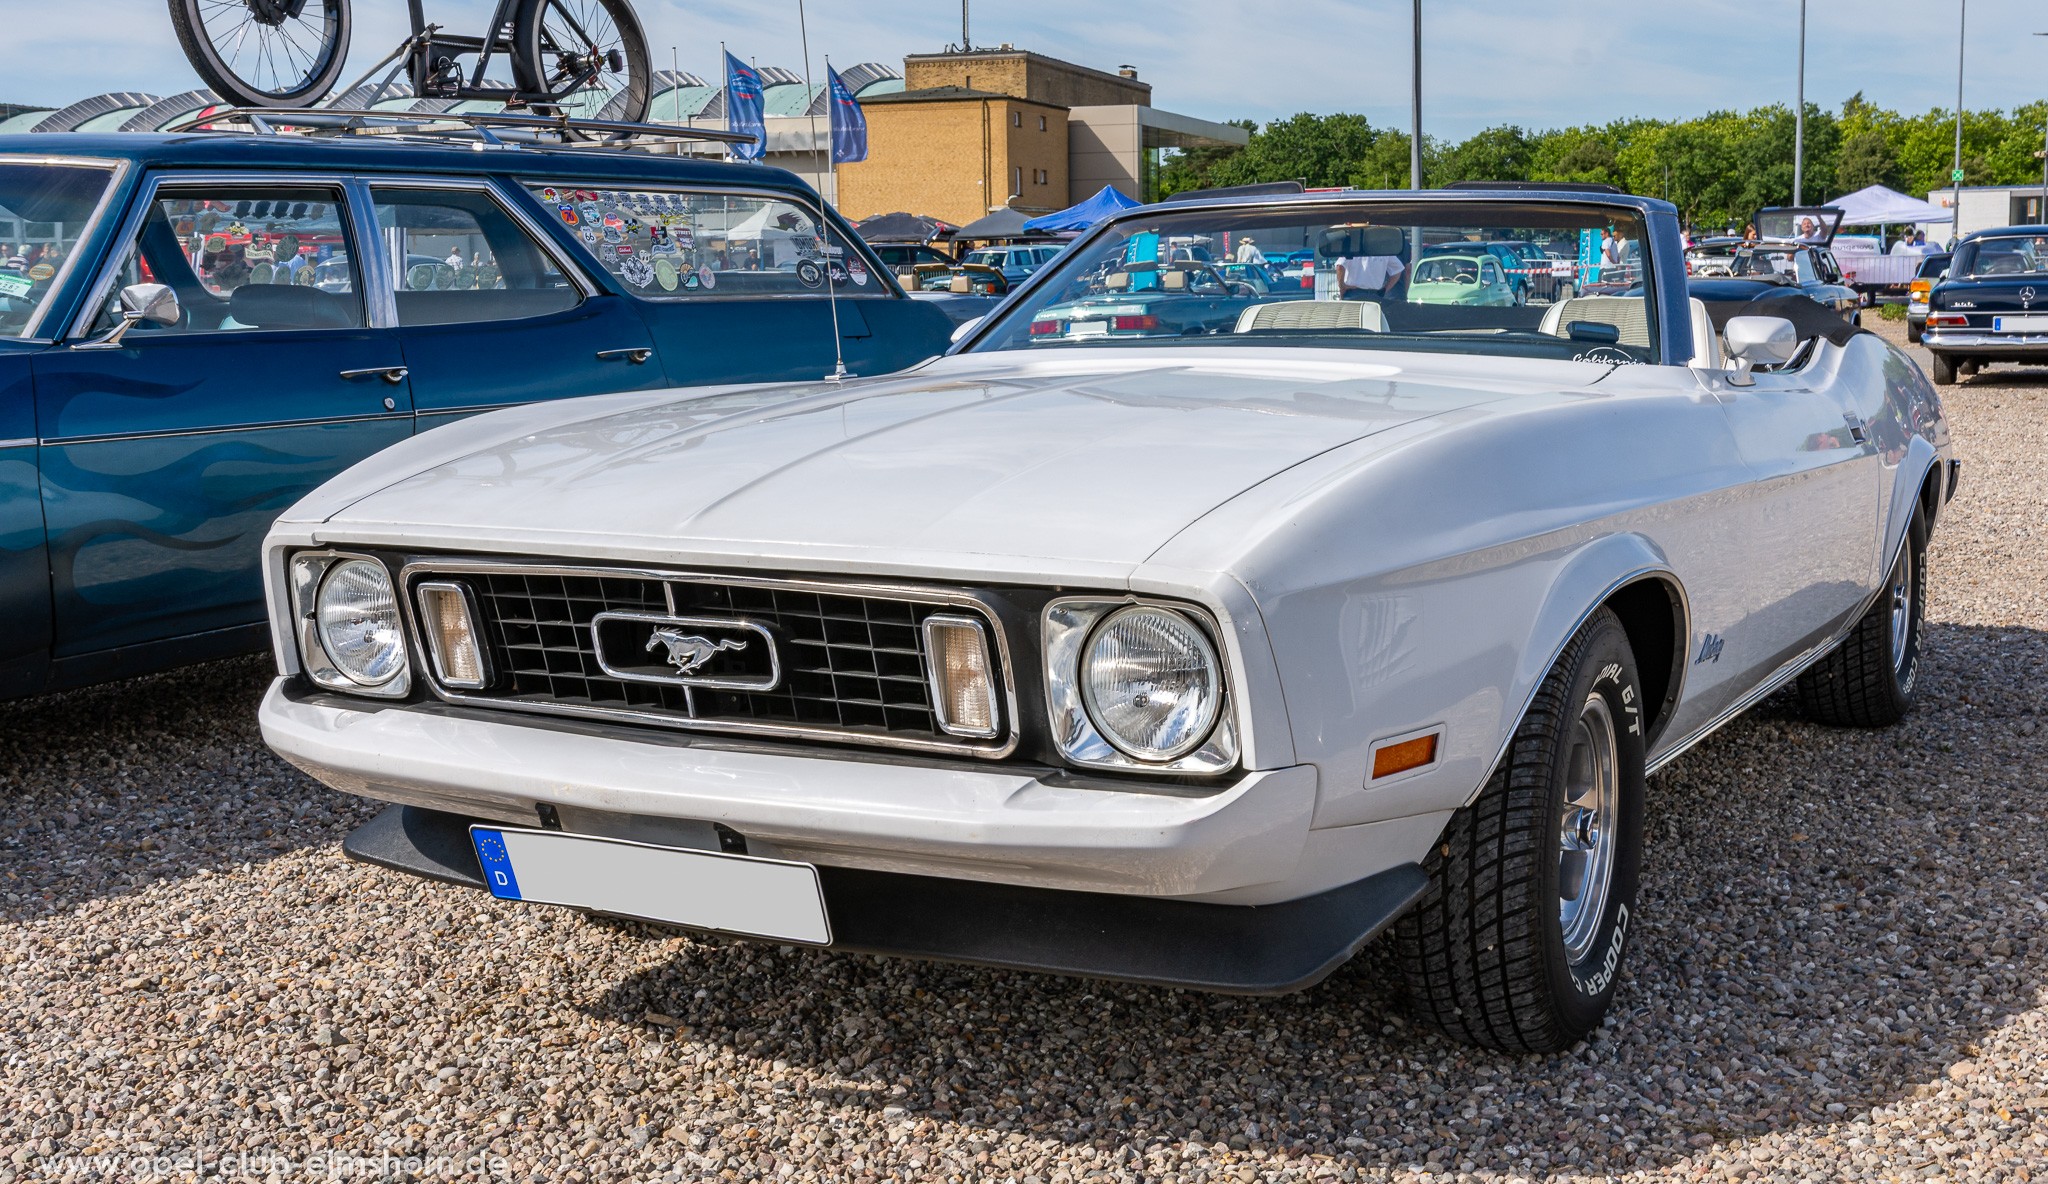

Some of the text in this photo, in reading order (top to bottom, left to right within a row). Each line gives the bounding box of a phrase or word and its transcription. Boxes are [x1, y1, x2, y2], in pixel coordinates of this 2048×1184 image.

[1572, 353, 1647, 366] California
[1914, 552, 1926, 651] COOPER
[494, 870, 509, 886] D
[1584, 903, 1629, 997] COOPER
